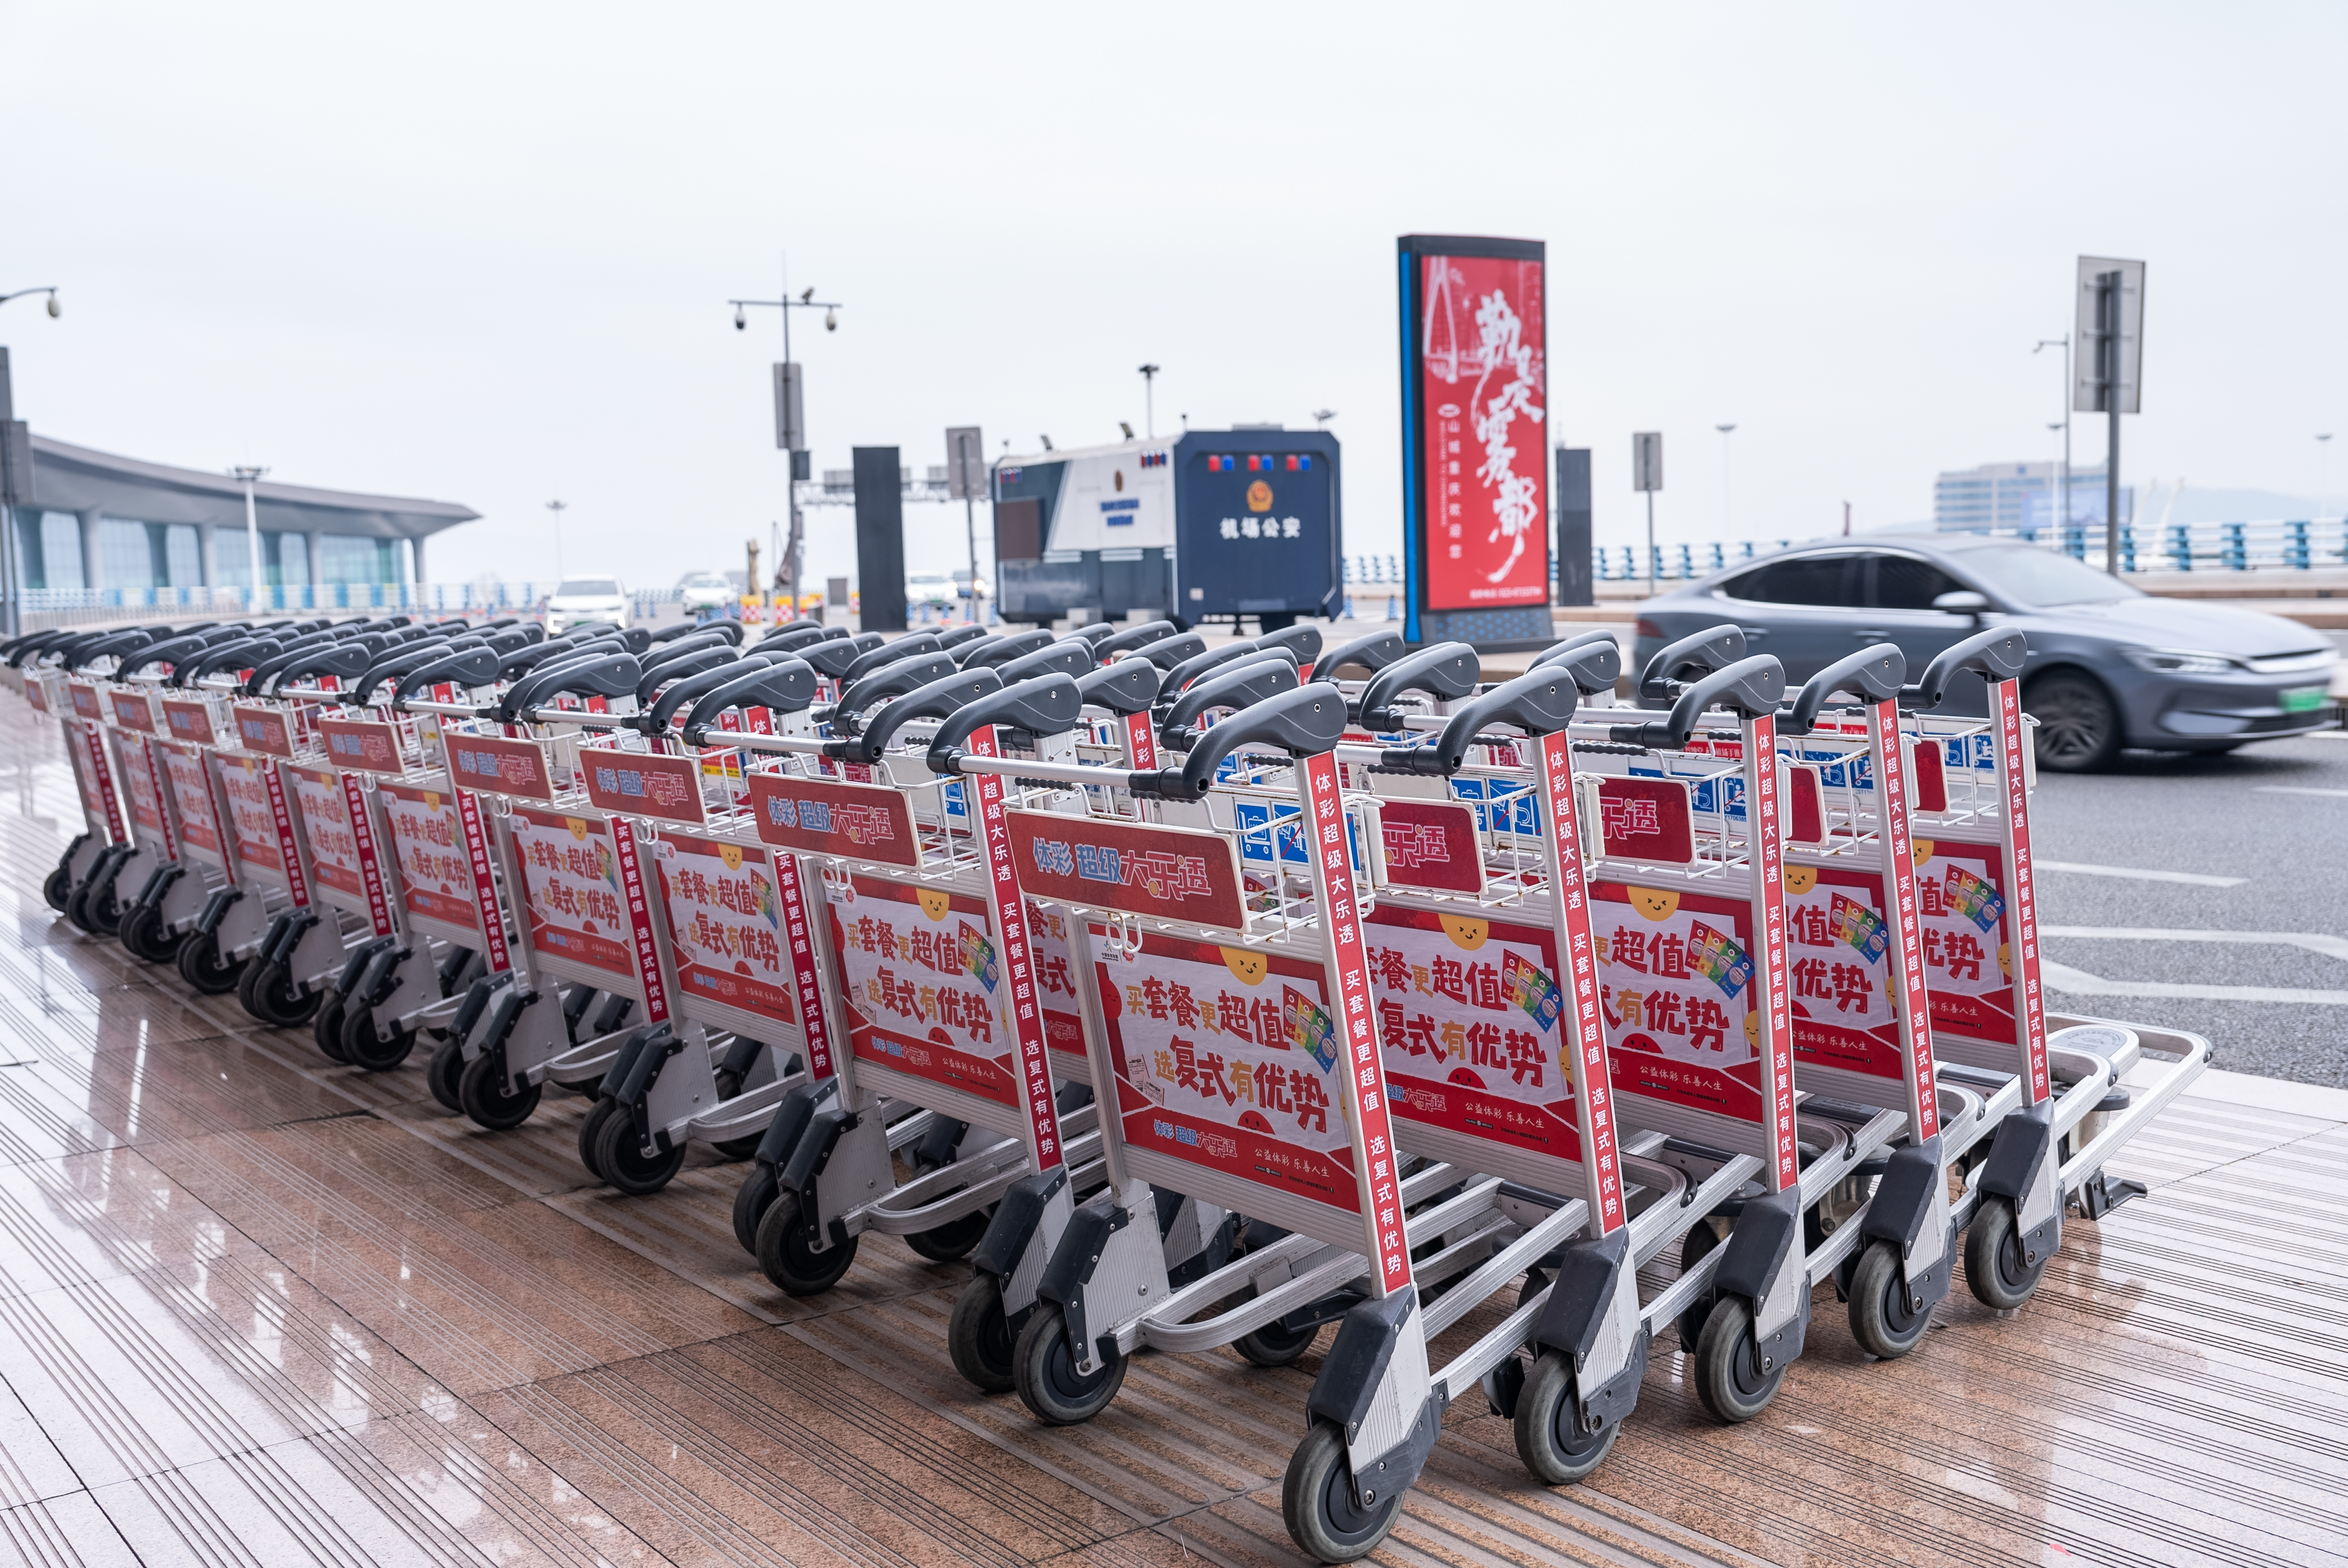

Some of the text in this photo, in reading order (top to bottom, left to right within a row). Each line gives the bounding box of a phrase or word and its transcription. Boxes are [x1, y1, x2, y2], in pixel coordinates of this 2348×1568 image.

[1219, 515, 1302, 540] 机场公安
[596, 766, 688, 806] 体彩 超级大乐透
[768, 795, 895, 845] 体彩 超级大乐透
[527, 839, 601, 881] 买套餐更超值
[672, 866, 758, 916] 买套餐更超值
[1032, 837, 1212, 901] 体彩 超级大乐透
[2004, 694, 2045, 1089] 体彩超级大乐透 买套餐更超值 选复式有优势
[543, 876, 621, 931] 选复式有优势
[617, 826, 663, 1013] 买套餐更超值 选复式有优势
[1788, 903, 1835, 948] 值
[1882, 715, 1934, 1126] 体彩超级大乐透 买套餐更超值 选复式有优势
[688, 910, 780, 974] 选复式有优势
[779, 854, 827, 1068] 买套餐更超值 选复式有优势
[847, 914, 963, 977] 买套餐更超值
[1758, 734, 1792, 1174] 体彩超级大乐透 买套餐更超值 选复式有优势
[867, 969, 994, 1044] 选复式有优势
[1126, 975, 1291, 1051] 买套餐更超值
[1550, 750, 1617, 1217] 体彩超级大乐透 买套餐更超值 选复式有优势
[1940, 1000, 1979, 1017] 乐善人生
[1003, 901, 1034, 1020] 买套餐更超值
[1025, 1039, 1053, 1154] 选复式有优势
[1315, 773, 1402, 1275] 体彩超级大乐透 买套餐更超值 选复式有优势
[1379, 997, 1547, 1088] 复式有优势
[1830, 1036, 1867, 1051] 乐善人生
[943, 1058, 997, 1080] 公益体彩 乐善人生
[1154, 1034, 1330, 1133] 选复式有优势
[1640, 1065, 1678, 1082] 公益体彩
[1682, 1074, 1723, 1091] 乐善人生
[1154, 1120, 1238, 1158] 体彩 超级大乐透
[1465, 1101, 1502, 1119] 公益体彩
[1506, 1111, 1544, 1129] 乐善人生
[1255, 1148, 1290, 1166] 公益体彩
[1294, 1158, 1330, 1177] 乐善人生
